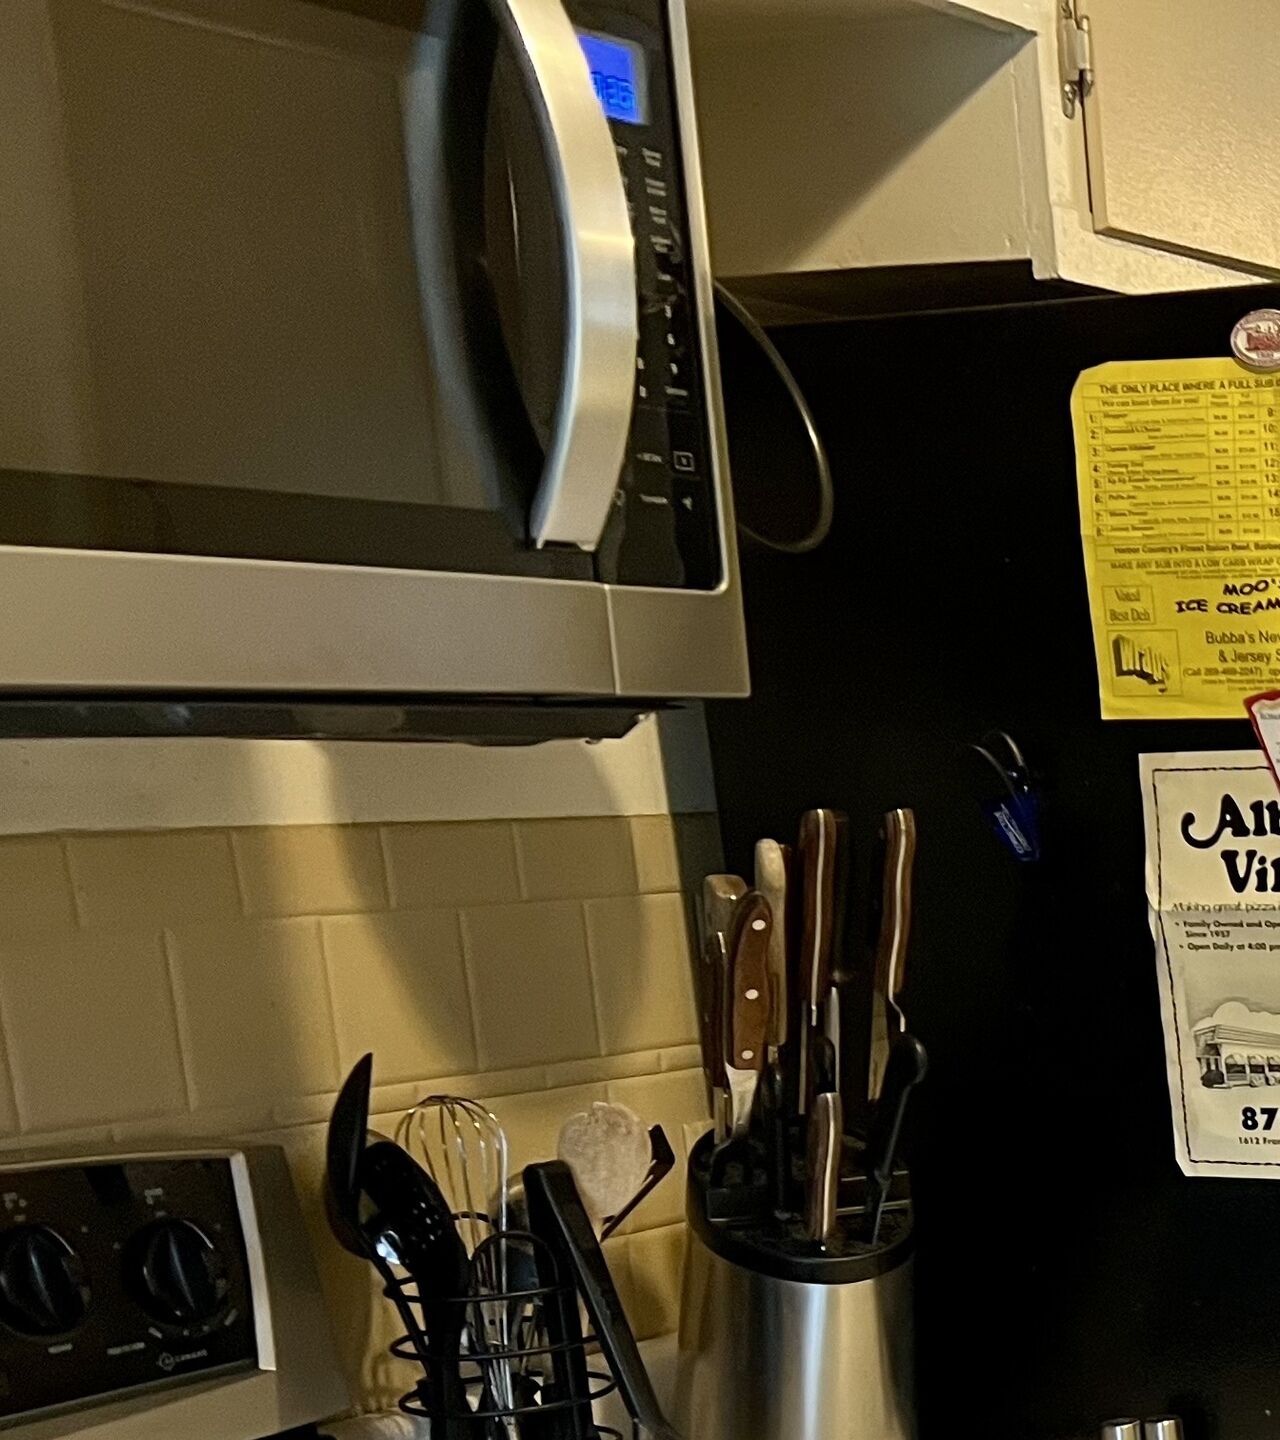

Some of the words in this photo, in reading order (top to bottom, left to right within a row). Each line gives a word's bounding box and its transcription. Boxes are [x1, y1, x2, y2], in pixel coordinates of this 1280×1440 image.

[1100, 385, 1119, 394] THE
[1122, 384, 1149, 394] ONLY
[1150, 382, 1179, 393] PLACE
[1183, 381, 1215, 392] WHERE
[1220, 380, 1226, 390] A
[1229, 379, 1253, 389] FULL
[1254, 377, 1273, 388] SUB
[1111, 561, 1133, 569] MAKE
[1136, 560, 1152, 569] ANY
[1155, 560, 1171, 569] SUB
[1173, 559, 1192, 569] INTO
[1203, 559, 1220, 568] LOW
[1223, 558, 1246, 567] CARB
[1248, 558, 1274, 566] WRAP
[1175, 599, 1209, 614] ICE
[1110, 609, 1130, 622] Best
[1205, 630, 1255, 645] Bubba's
[1219, 649, 1228, 663] &
[1231, 649, 1271, 666] Jersey
[1213, 901, 1242, 913] great
[1246, 903, 1277, 913] pizza
[1183, 921, 1211, 930] Family
[1213, 920, 1244, 928] Owned
[1246, 920, 1262, 928] and
[1188, 943, 1211, 952] Open
[1213, 943, 1234, 952] Daily
[1236, 943, 1246, 951] at
[1248, 943, 1267, 951] 4:00
[1239, 1137, 1260, 1145] 1612
